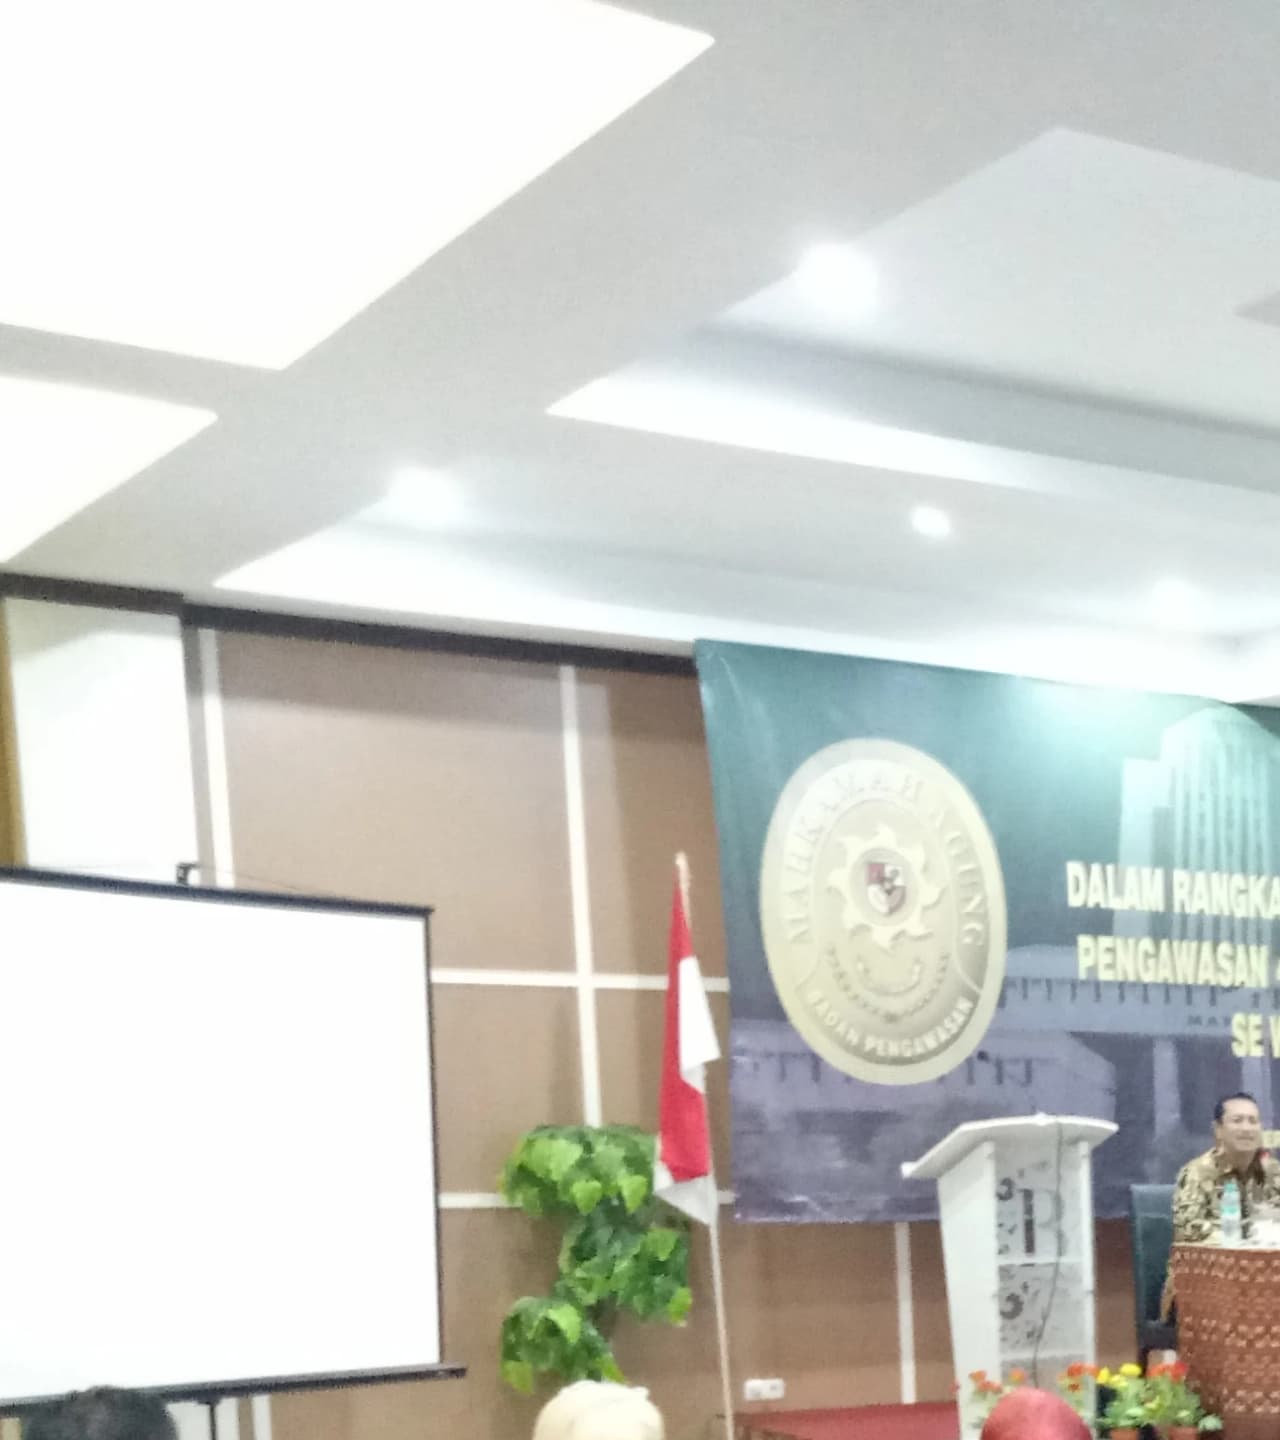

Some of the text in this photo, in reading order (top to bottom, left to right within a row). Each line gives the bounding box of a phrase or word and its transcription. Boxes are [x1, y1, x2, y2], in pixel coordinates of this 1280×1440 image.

[1066, 861, 1165, 912] DALAM
[1077, 934, 1269, 989] PENGAWASAN
[863, 995, 975, 1057] PENGAWASAN
[1231, 1013, 1265, 1057] SE
